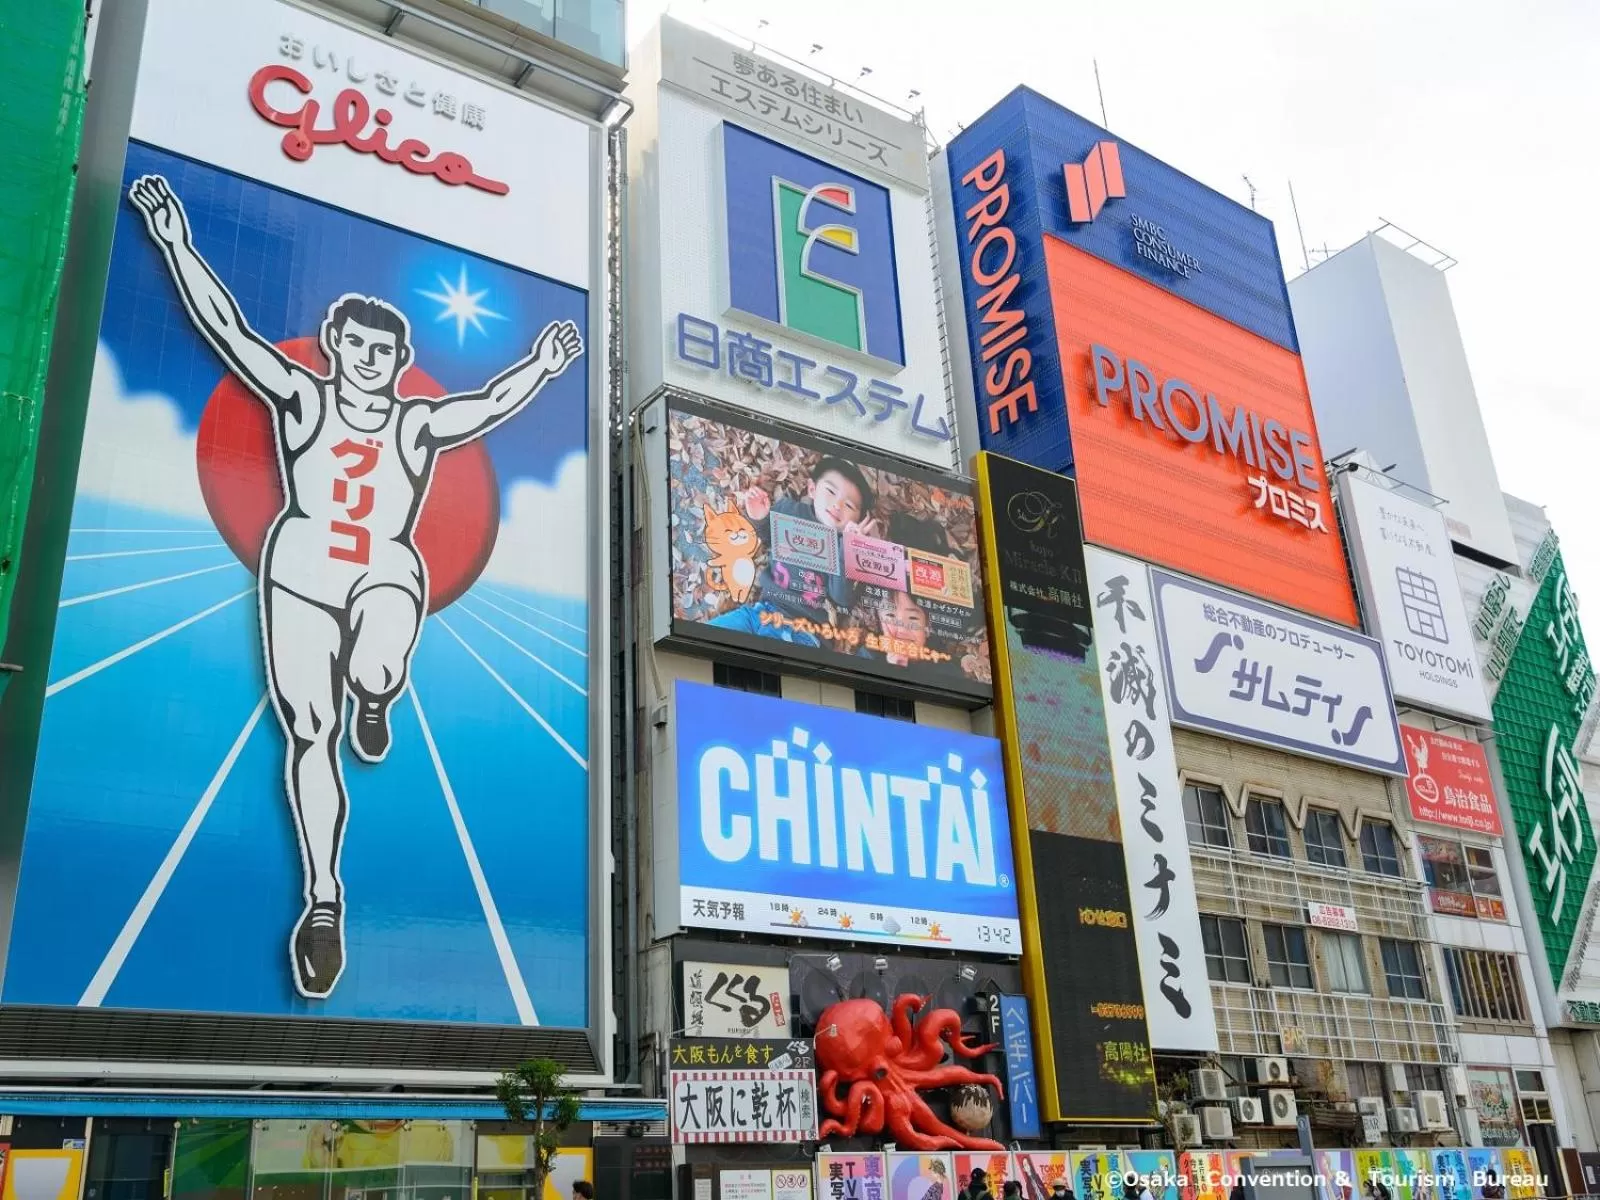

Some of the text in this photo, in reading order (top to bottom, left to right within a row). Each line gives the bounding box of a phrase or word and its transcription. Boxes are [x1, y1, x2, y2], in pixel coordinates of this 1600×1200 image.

[278, 34, 487, 131] おいしさと健康
[732, 51, 863, 124] 夢ある住まい
[710, 74, 888, 167] エステムシリーズ
[1131, 212, 1168, 241] SMBC
[1133, 227, 1203, 274] CONSUMER
[1136, 240, 1192, 280] FINANCE
[962, 148, 1038, 435] PROMISE
[677, 312, 950, 442] 日商エステム
[1089, 343, 1321, 493] PROMISE
[328, 437, 384, 566] グリコ
[1247, 475, 1328, 533] プロミス
[1202, 602, 1355, 660] 総合不動産のプロデューサー
[1229, 658, 1343, 723] サムティ
[1097, 575, 1192, 1019] 不滅のミナミ
[692, 898, 746, 922] 天気予報
[769, 902, 789, 914] 18時
[816, 907, 838, 918] 24時
[869, 912, 884, 923] 6時
[909, 916, 929, 927] 12時
[704, 971, 771, 1028] くくる
[989, 994, 1000, 1034] 2F
[672, 1043, 774, 1065] 大阪もんを食す
[794, 1056, 811, 1069] 2F
[1006, 1006, 1033, 1124] ペンギンバー
[680, 1081, 798, 1130] 大阪に乾杯
